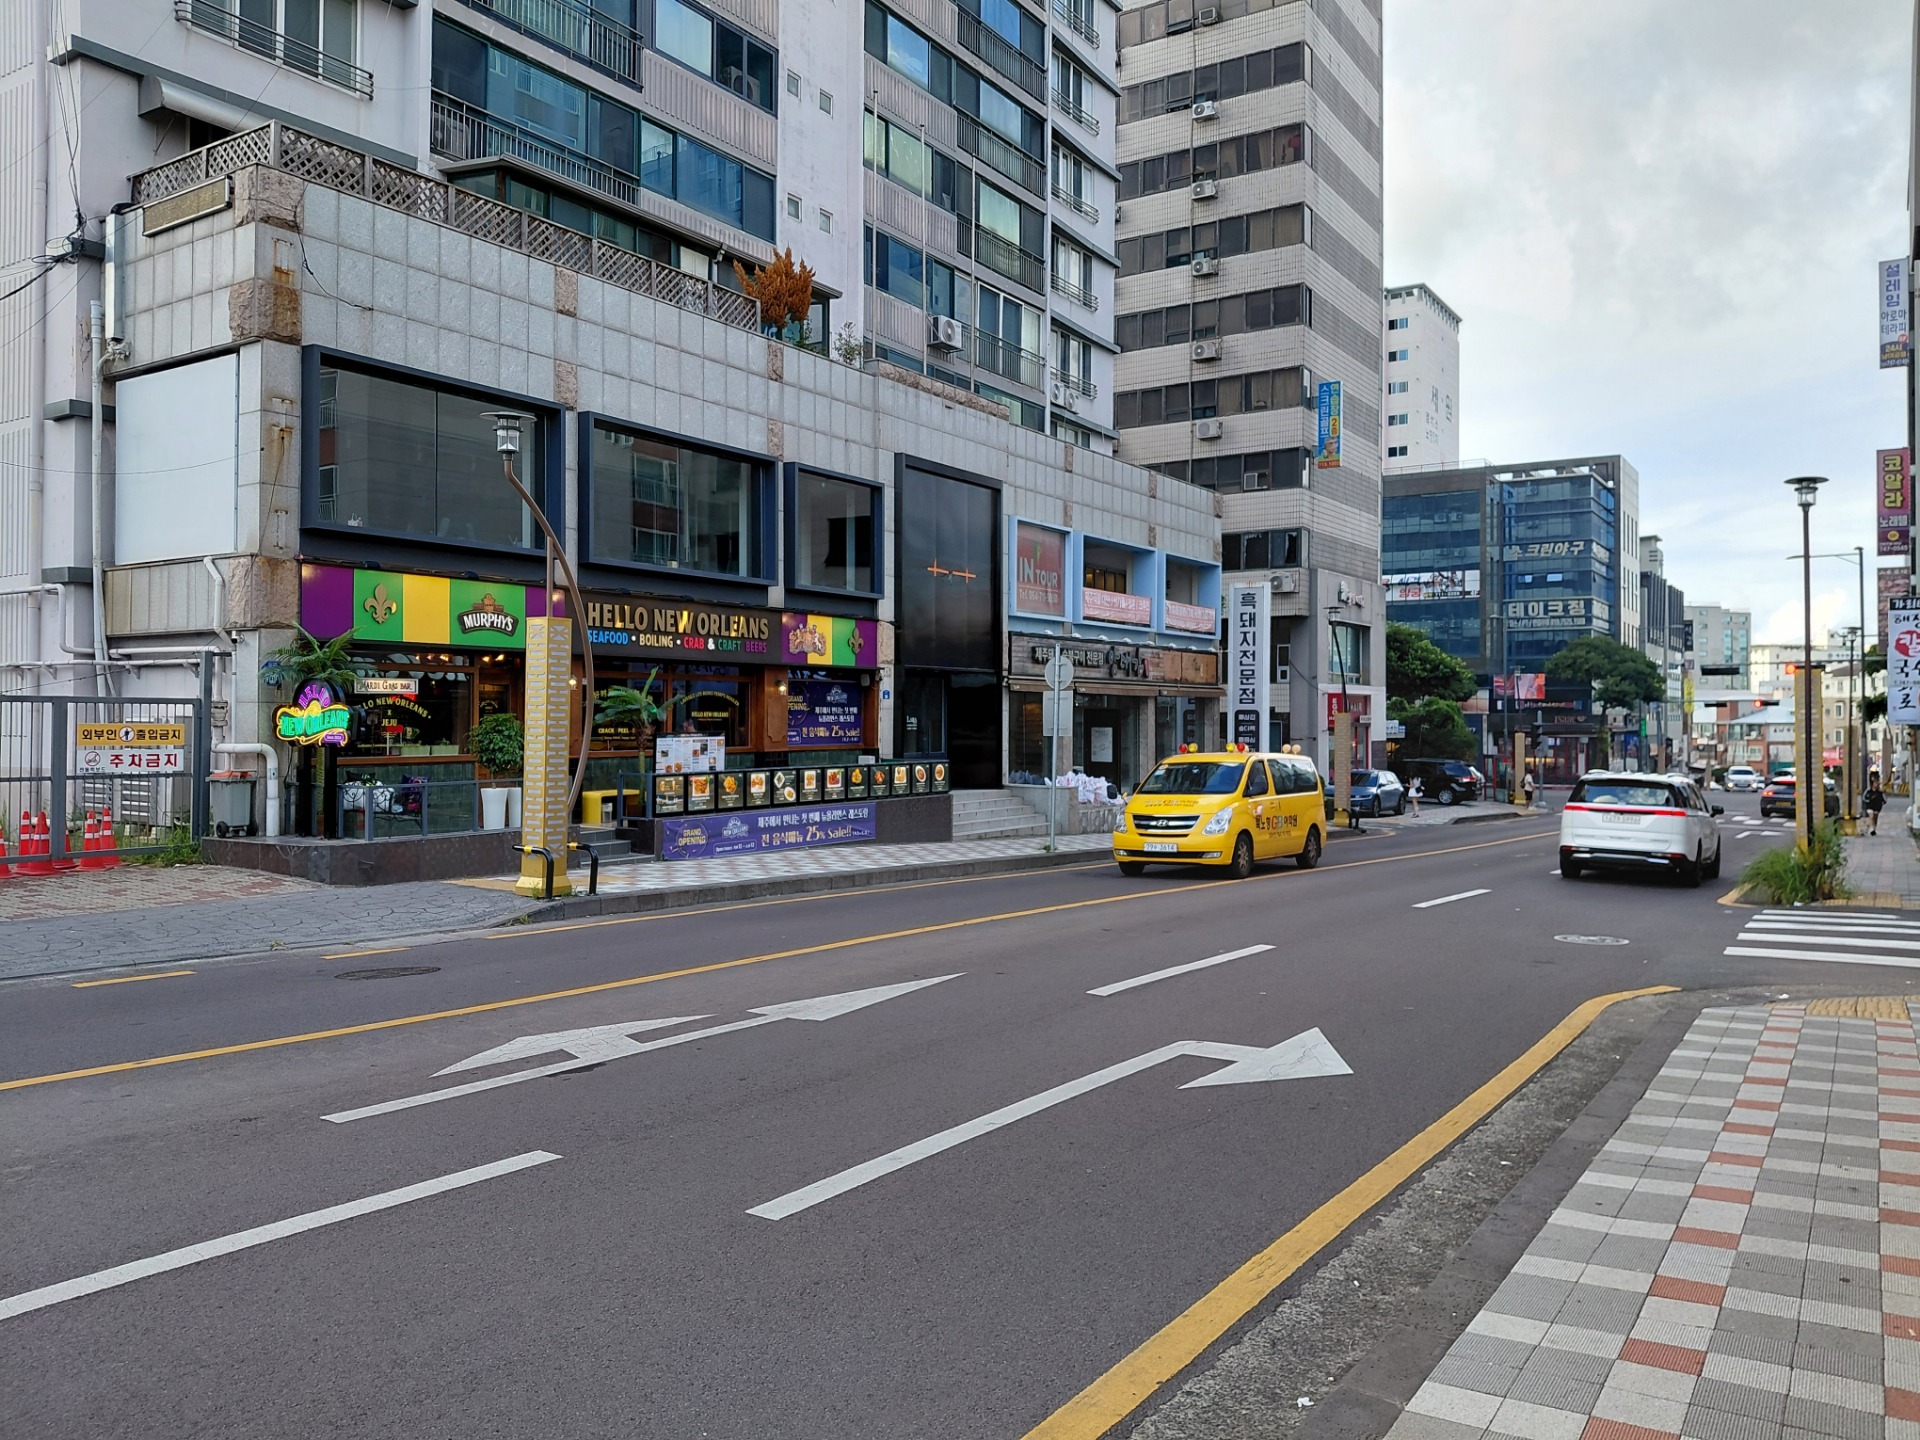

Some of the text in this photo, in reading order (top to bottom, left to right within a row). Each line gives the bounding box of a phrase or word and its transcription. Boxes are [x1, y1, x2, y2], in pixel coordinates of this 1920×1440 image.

[1885, 264, 1901, 308] 설레임
[1881, 308, 1907, 322] 아로마
[1881, 322, 1907, 336] 테라피
[1320, 385, 1329, 438] 스크린골프
[1884, 455, 1903, 508] 코알라
[1019, 557, 1058, 588] IN TOUR
[1508, 600, 1585, 618] 테이크짐
[587, 602, 769, 640] HELLO NEW ORLEANS
[588, 629, 767, 653] SEAFOOD BOILING CRAB & CRAFT BEERS
[1239, 592, 1257, 705] 흑돼지전문점
[1086, 651, 1104, 665] 전문점
[298, 684, 332, 709] HELLO
[376, 696, 393, 706] NEW
[395, 698, 429, 718] ORLEANS
[787, 703, 807, 711] PENING
[281, 708, 349, 736] NEW ORLEANS
[381, 718, 398, 728] JEJU
[82, 729, 181, 741] 외부인 출입금지
[110, 753, 179, 769] 주차금지
[758, 816, 782, 828] 제주에서
[783, 814, 800, 826] 만나는
[801, 812, 807, 824] 첫
[848, 808, 869, 819] 레스토랑
[678, 835, 706, 846] OPENING
[683, 827, 703, 836] GRAND
[761, 834, 770, 847] 전
[772, 830, 804, 846] 음식메뉴
[806, 825, 826, 842] 25%
